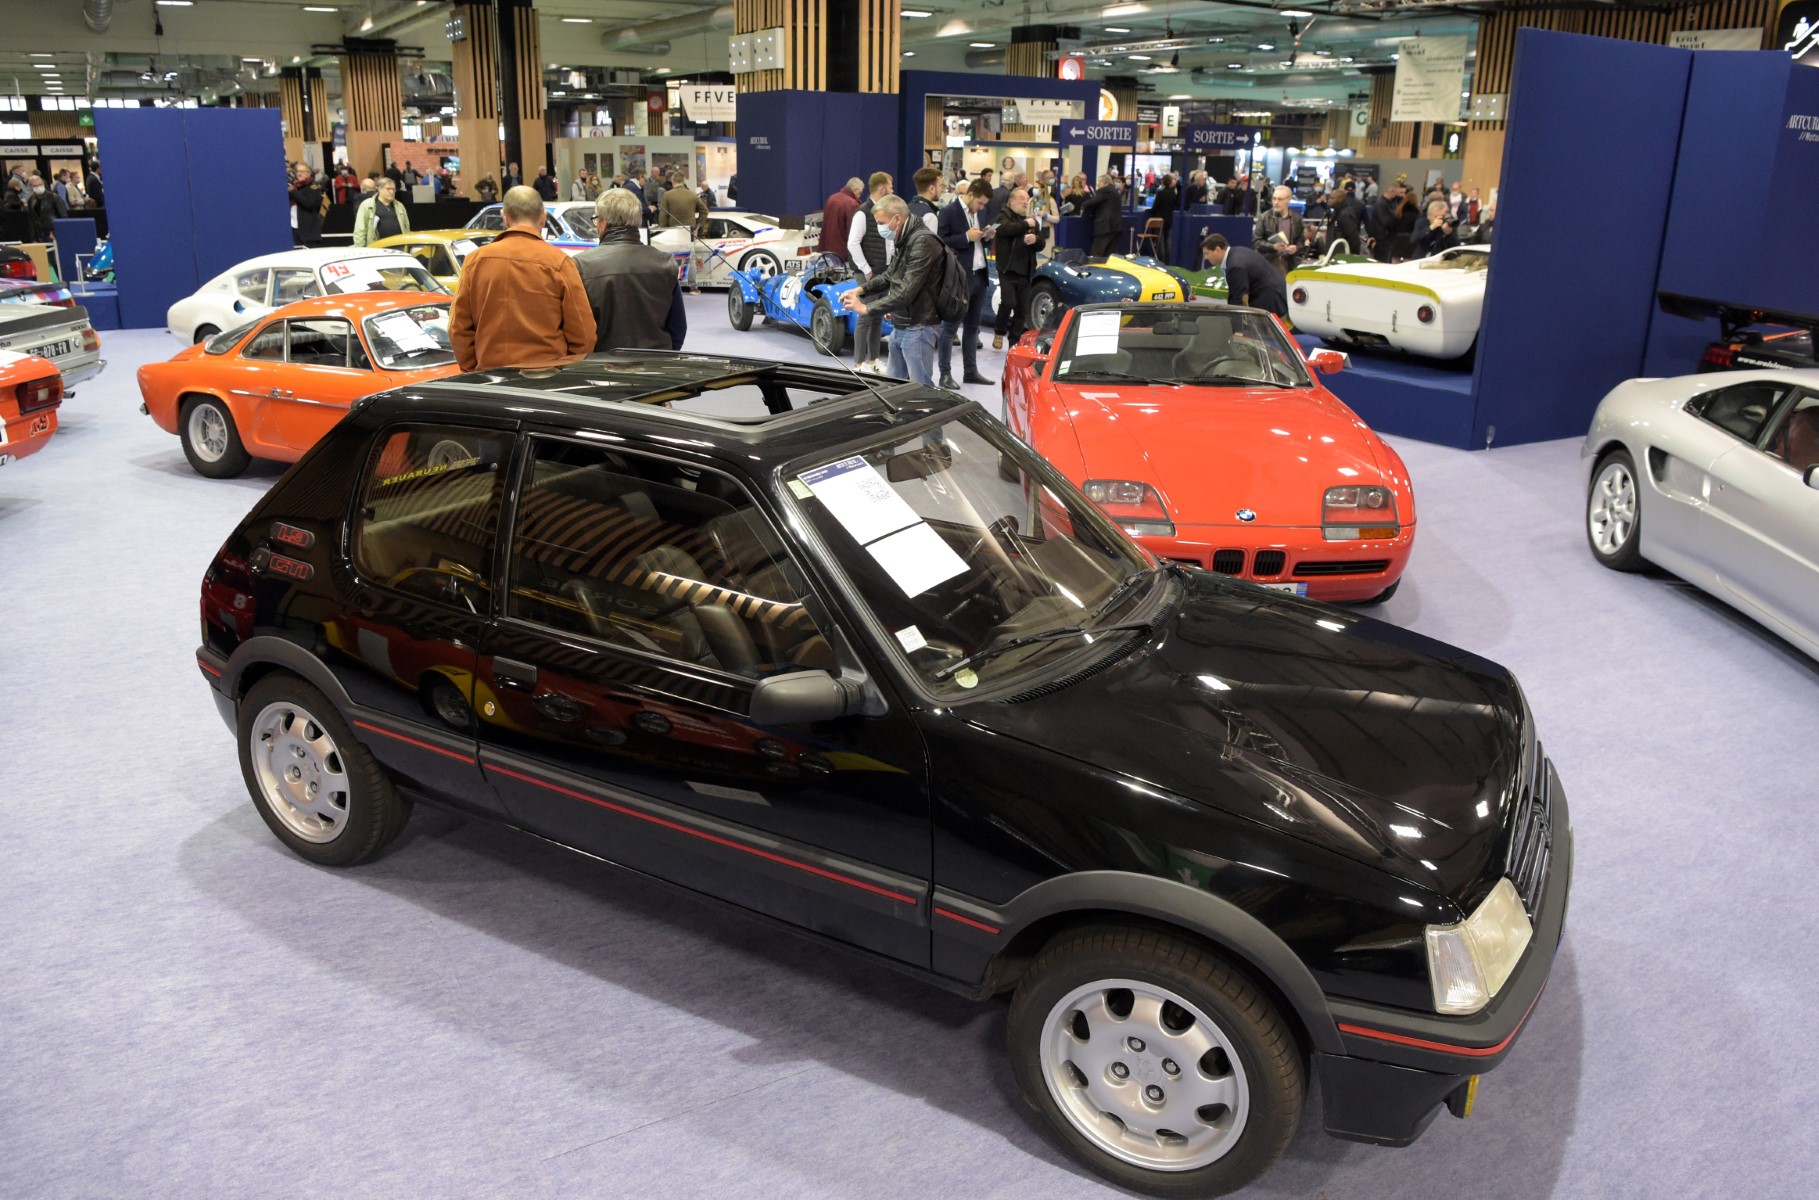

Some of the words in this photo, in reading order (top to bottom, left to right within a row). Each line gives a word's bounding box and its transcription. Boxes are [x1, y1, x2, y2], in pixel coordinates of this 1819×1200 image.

[694, 91, 734, 103] FFVE
[1167, 114, 1174, 127] E
[1086, 126, 1132, 141] SORTIE
[1193, 130, 1234, 144] SORTIE
